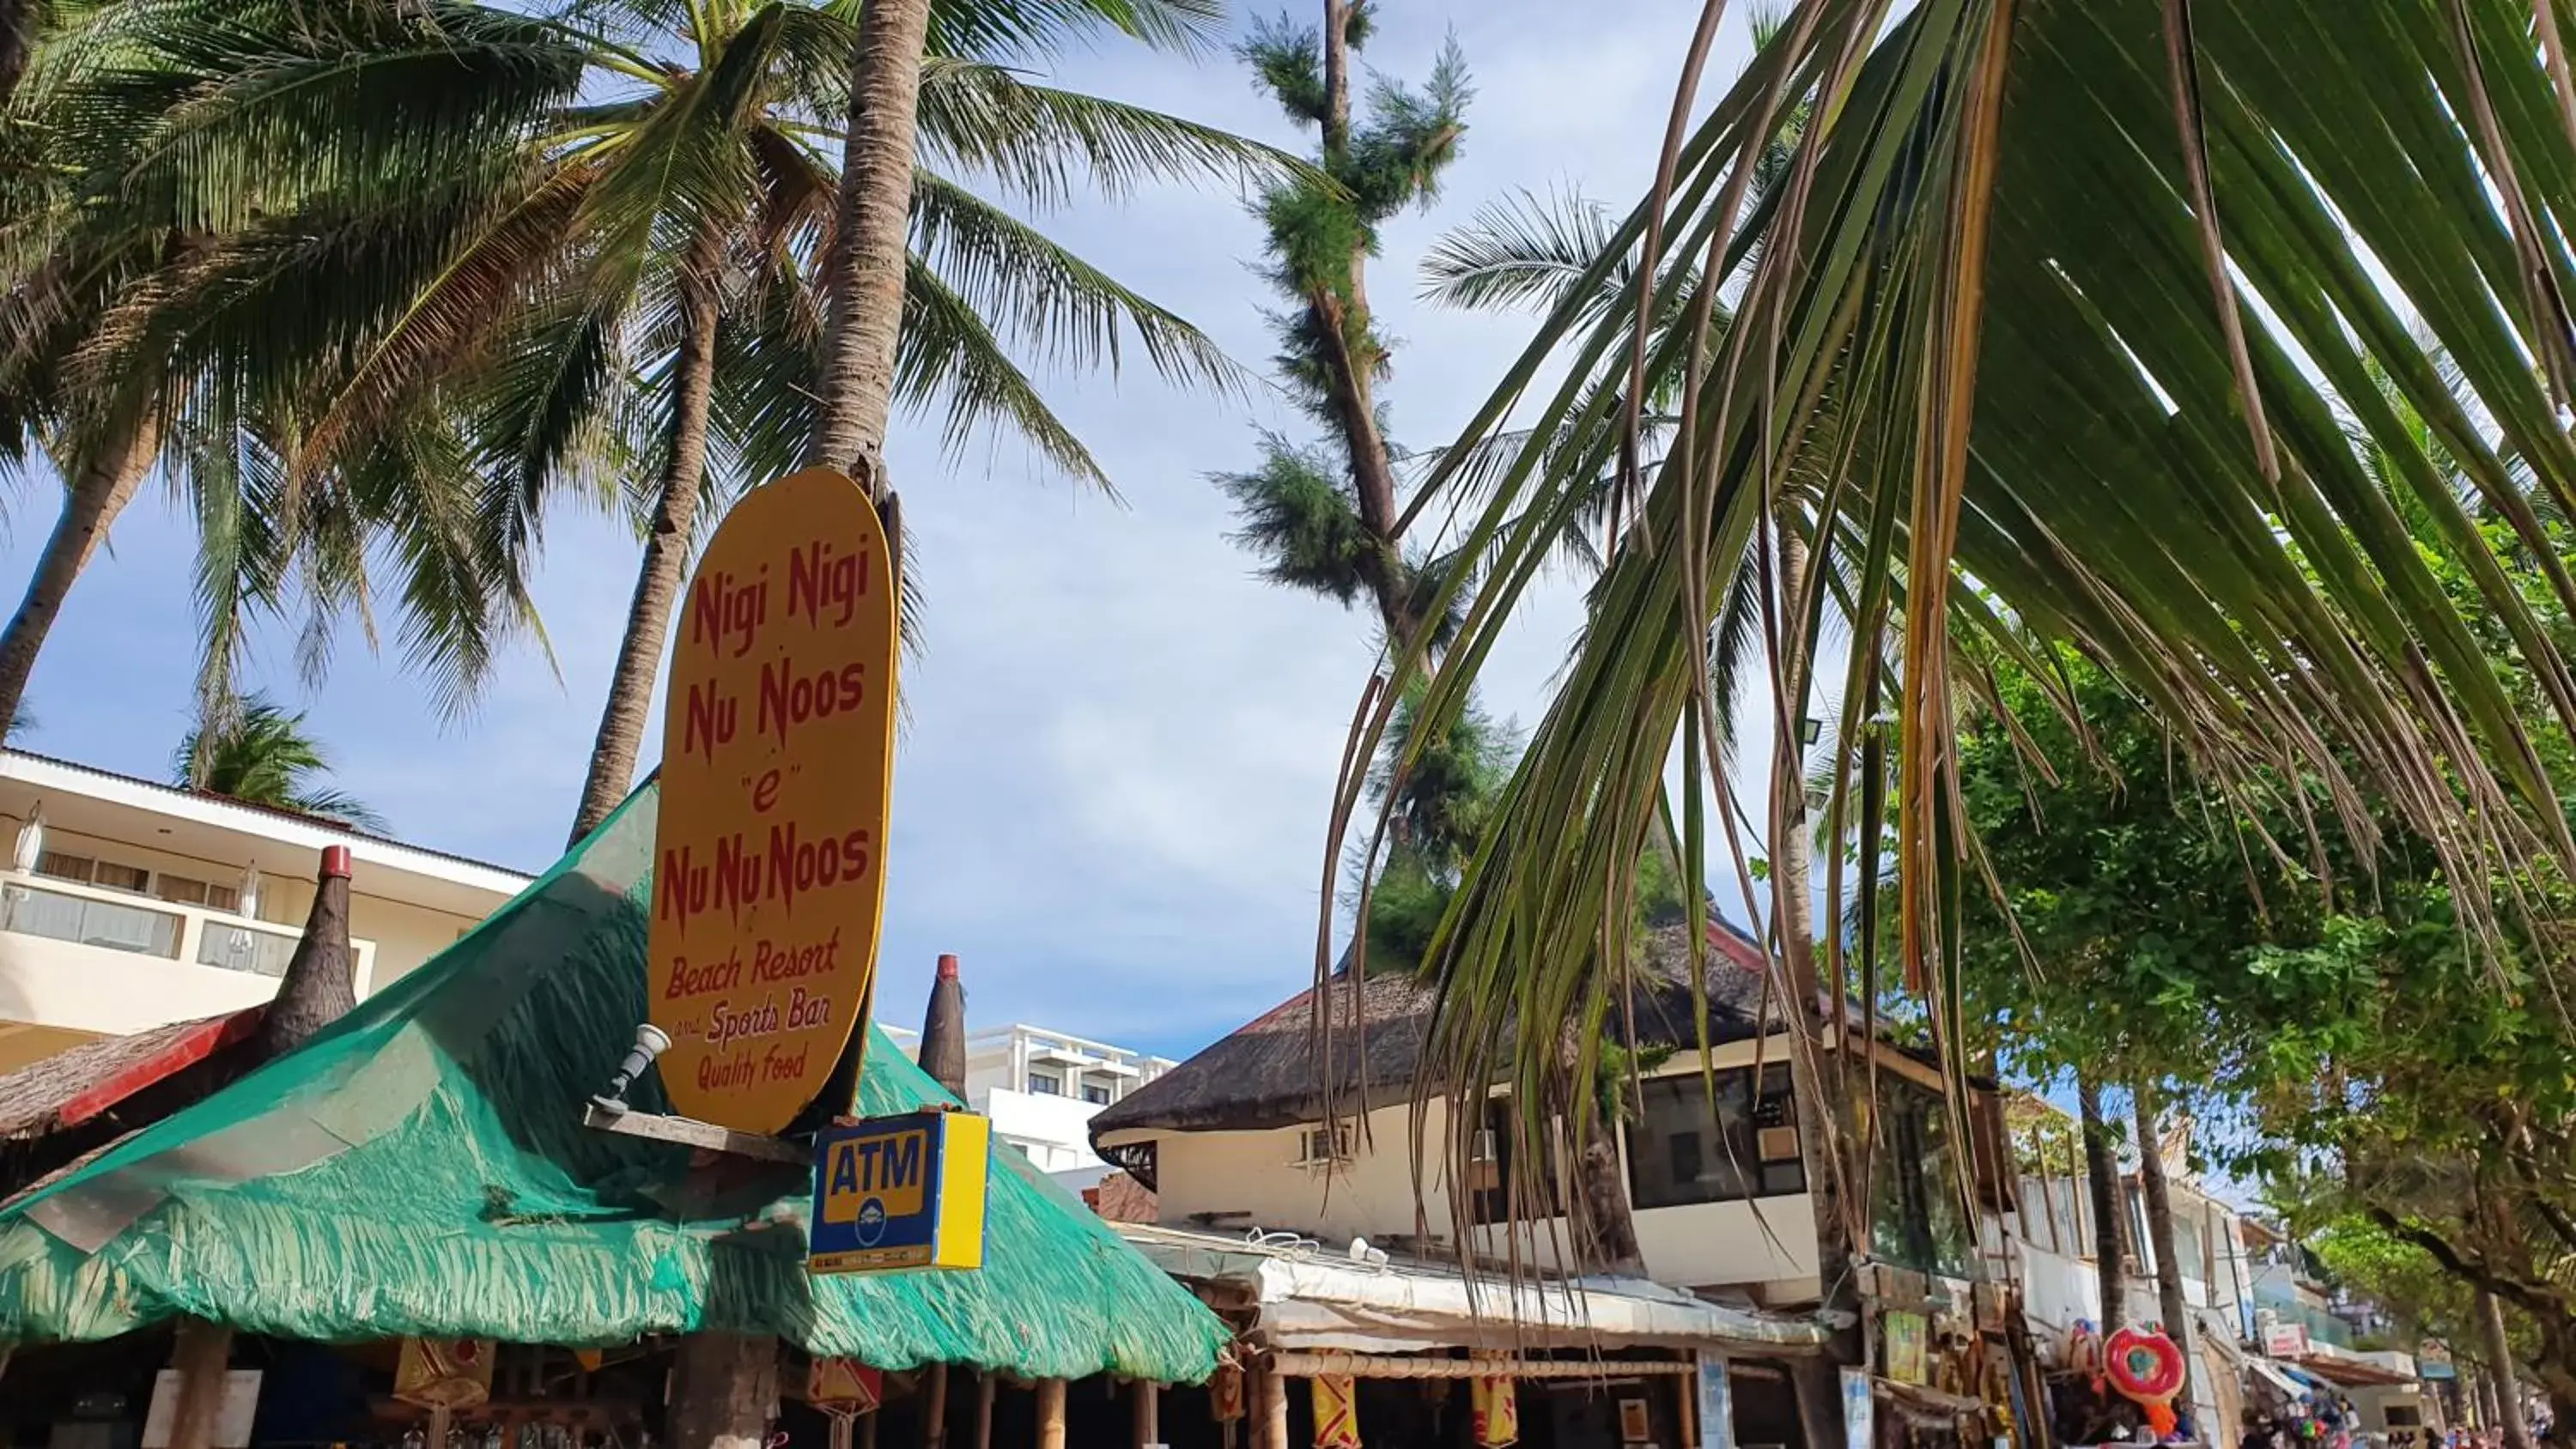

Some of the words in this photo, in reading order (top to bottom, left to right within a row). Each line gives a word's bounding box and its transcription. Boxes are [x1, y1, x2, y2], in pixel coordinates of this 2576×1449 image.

[693, 563, 769, 659] Nigi
[787, 533, 869, 630] Nigi
[665, 947, 743, 999] Beach
[750, 925, 840, 984] Resort
[705, 993, 780, 1053] Sports
[787, 987, 830, 1028] Bar
[697, 1049, 756, 1092] Quality
[830, 1136, 921, 1196] ATM
